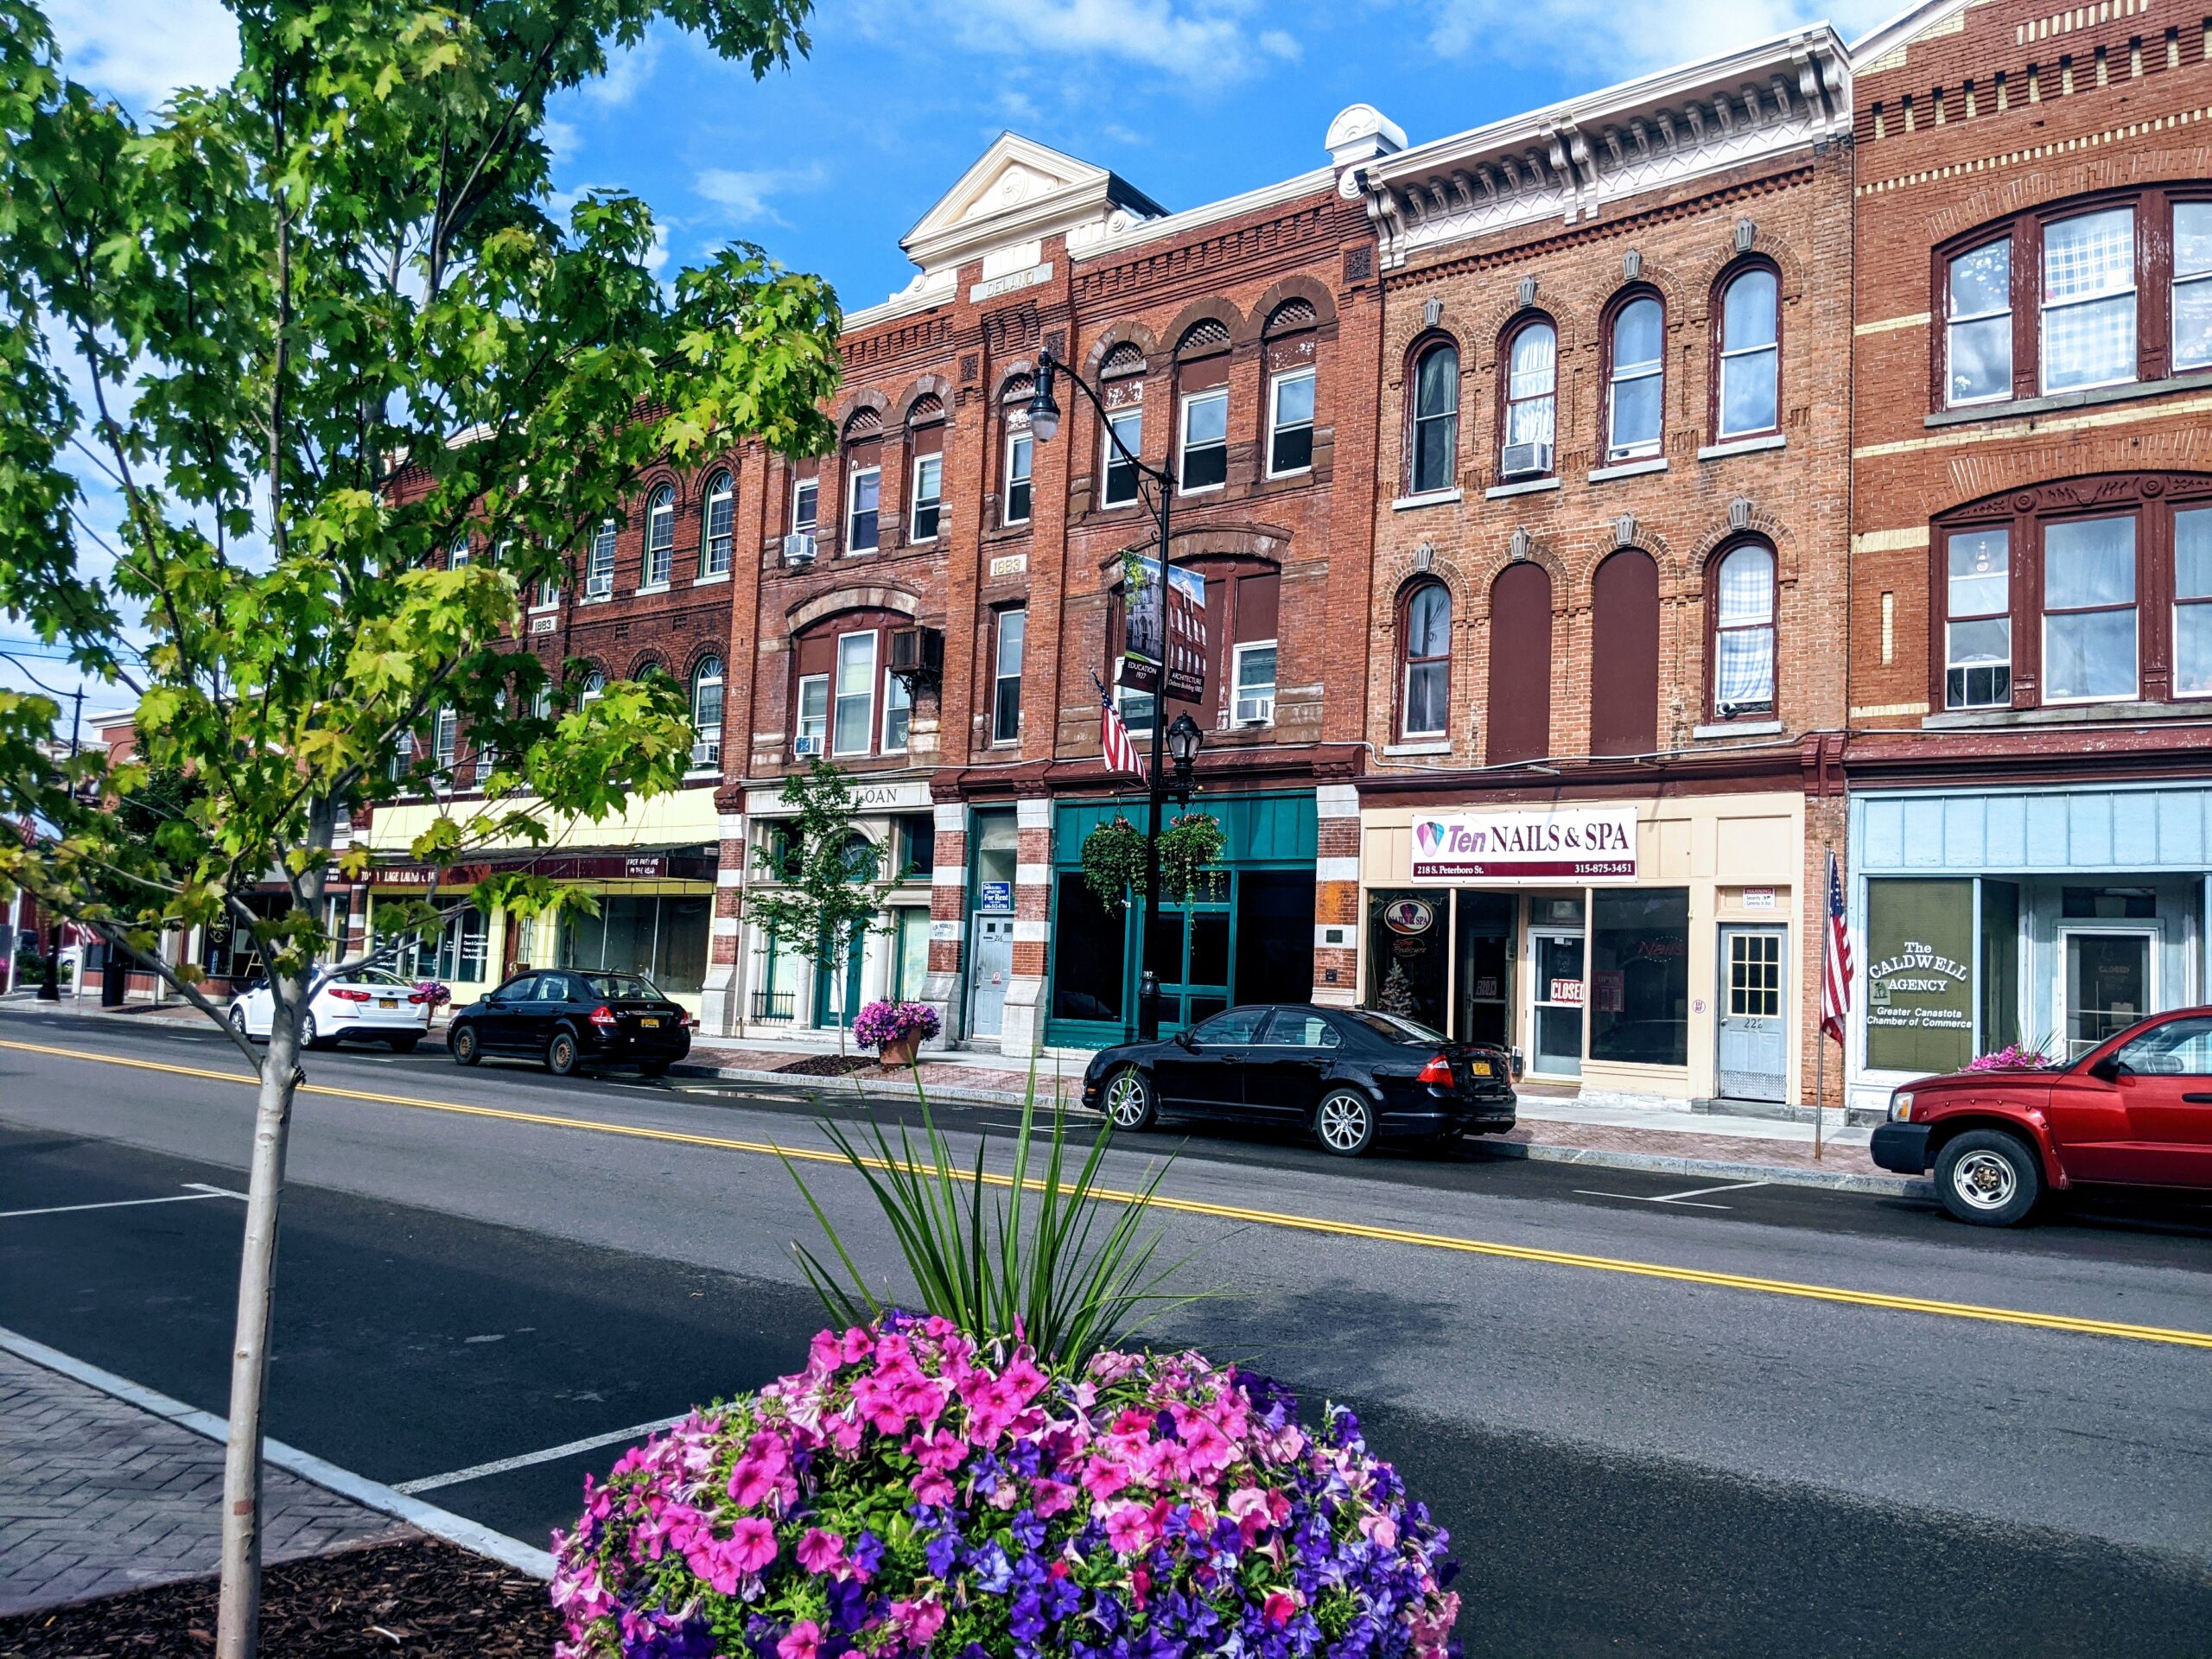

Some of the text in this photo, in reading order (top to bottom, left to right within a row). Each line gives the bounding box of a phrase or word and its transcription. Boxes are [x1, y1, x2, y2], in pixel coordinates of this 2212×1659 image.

[987, 270, 1034, 297] DELANO
[995, 559, 1020, 574] 1883
[535, 620, 551, 631] 1883
[1128, 661, 1157, 675] EDUCATION
[1172, 672, 1202, 685] ARCHITECTURE
[1180, 683, 1194, 693] Building
[856, 788, 898, 804] LOAN
[1448, 823, 1629, 853] Ten NAILS & SPA
[1417, 865, 1484, 874] 218 S. Peterboro St.
[1574, 864, 1632, 874] 315-875-3451
[1389, 916, 1408, 925] NAILS
[1415, 916, 1428, 925] SPA
[1904, 942, 1932, 953] The
[1869, 954, 1967, 982] CALDWELL
[1887, 979, 1948, 991] AGENCY
[1877, 1007, 1962, 1018] Greater Canastota
[1866, 1015, 1973, 1028] Chamber of Commerce
